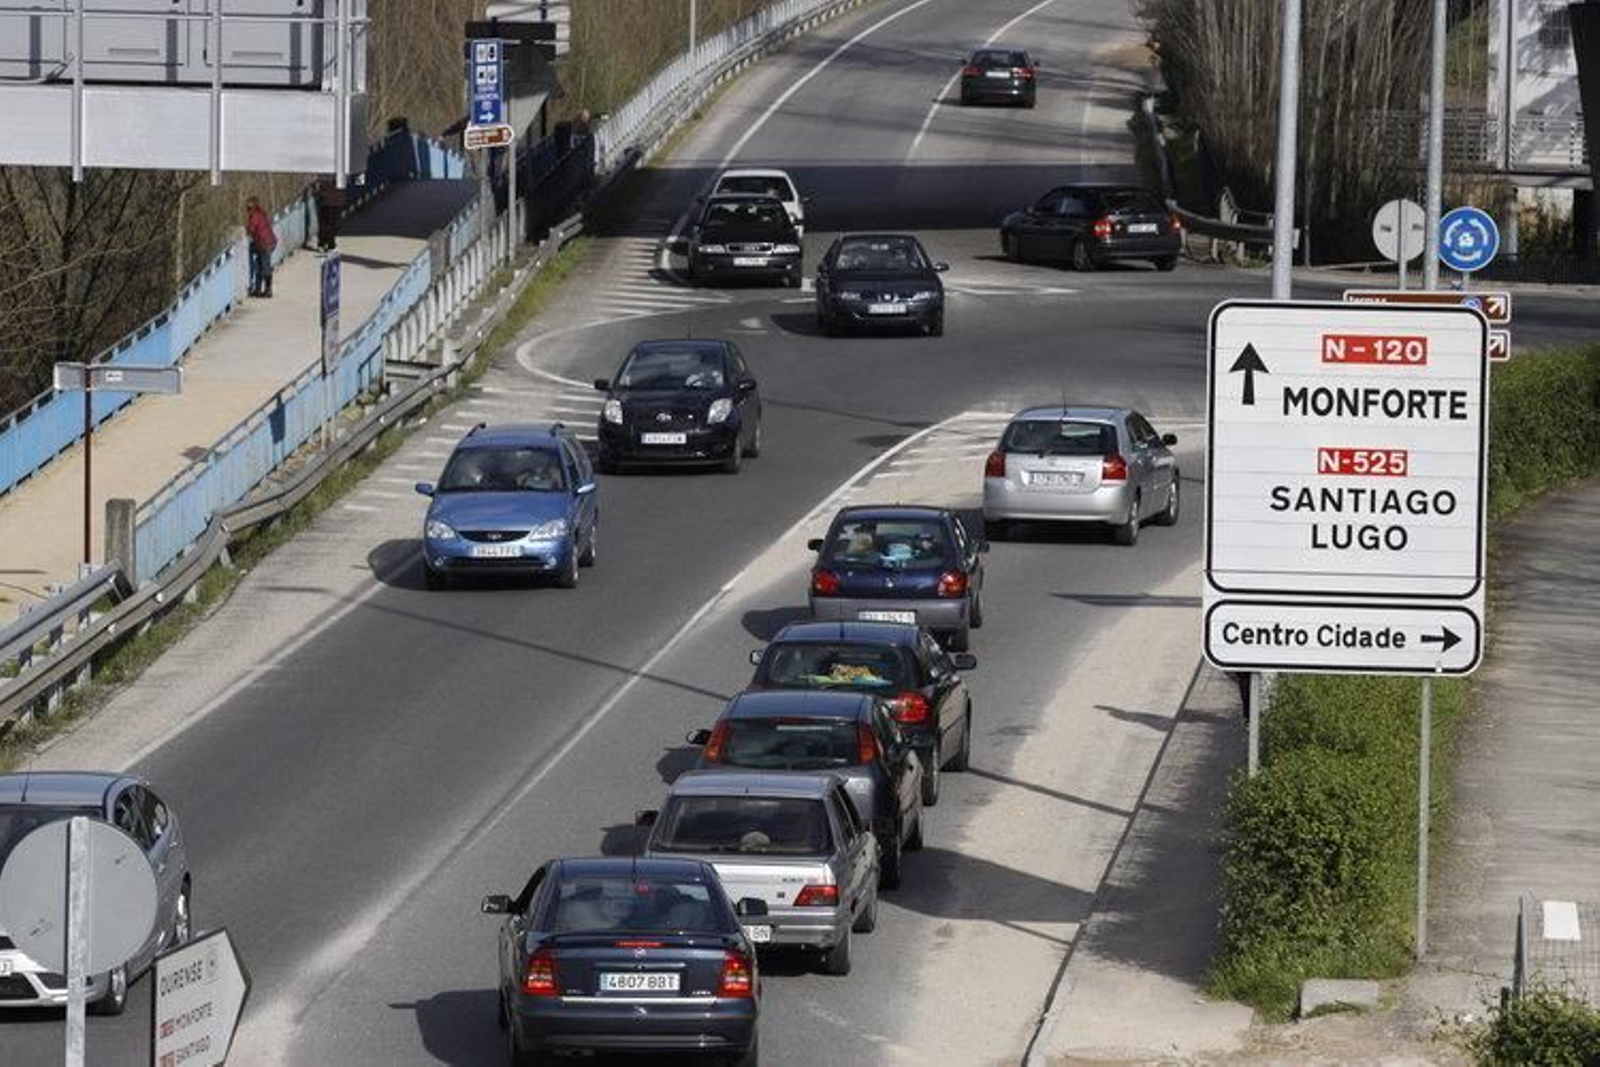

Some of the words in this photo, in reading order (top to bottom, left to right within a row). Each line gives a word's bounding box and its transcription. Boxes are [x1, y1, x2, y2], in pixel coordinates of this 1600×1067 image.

[1282, 386, 1468, 420] MONFORTE
[1319, 450, 1405, 474] N-525
[1270, 486, 1458, 516] SANTIAGO
[1311, 524, 1408, 551] LUGO
[1222, 622, 1309, 646] Centro
[1316, 624, 1407, 649] Cidade
